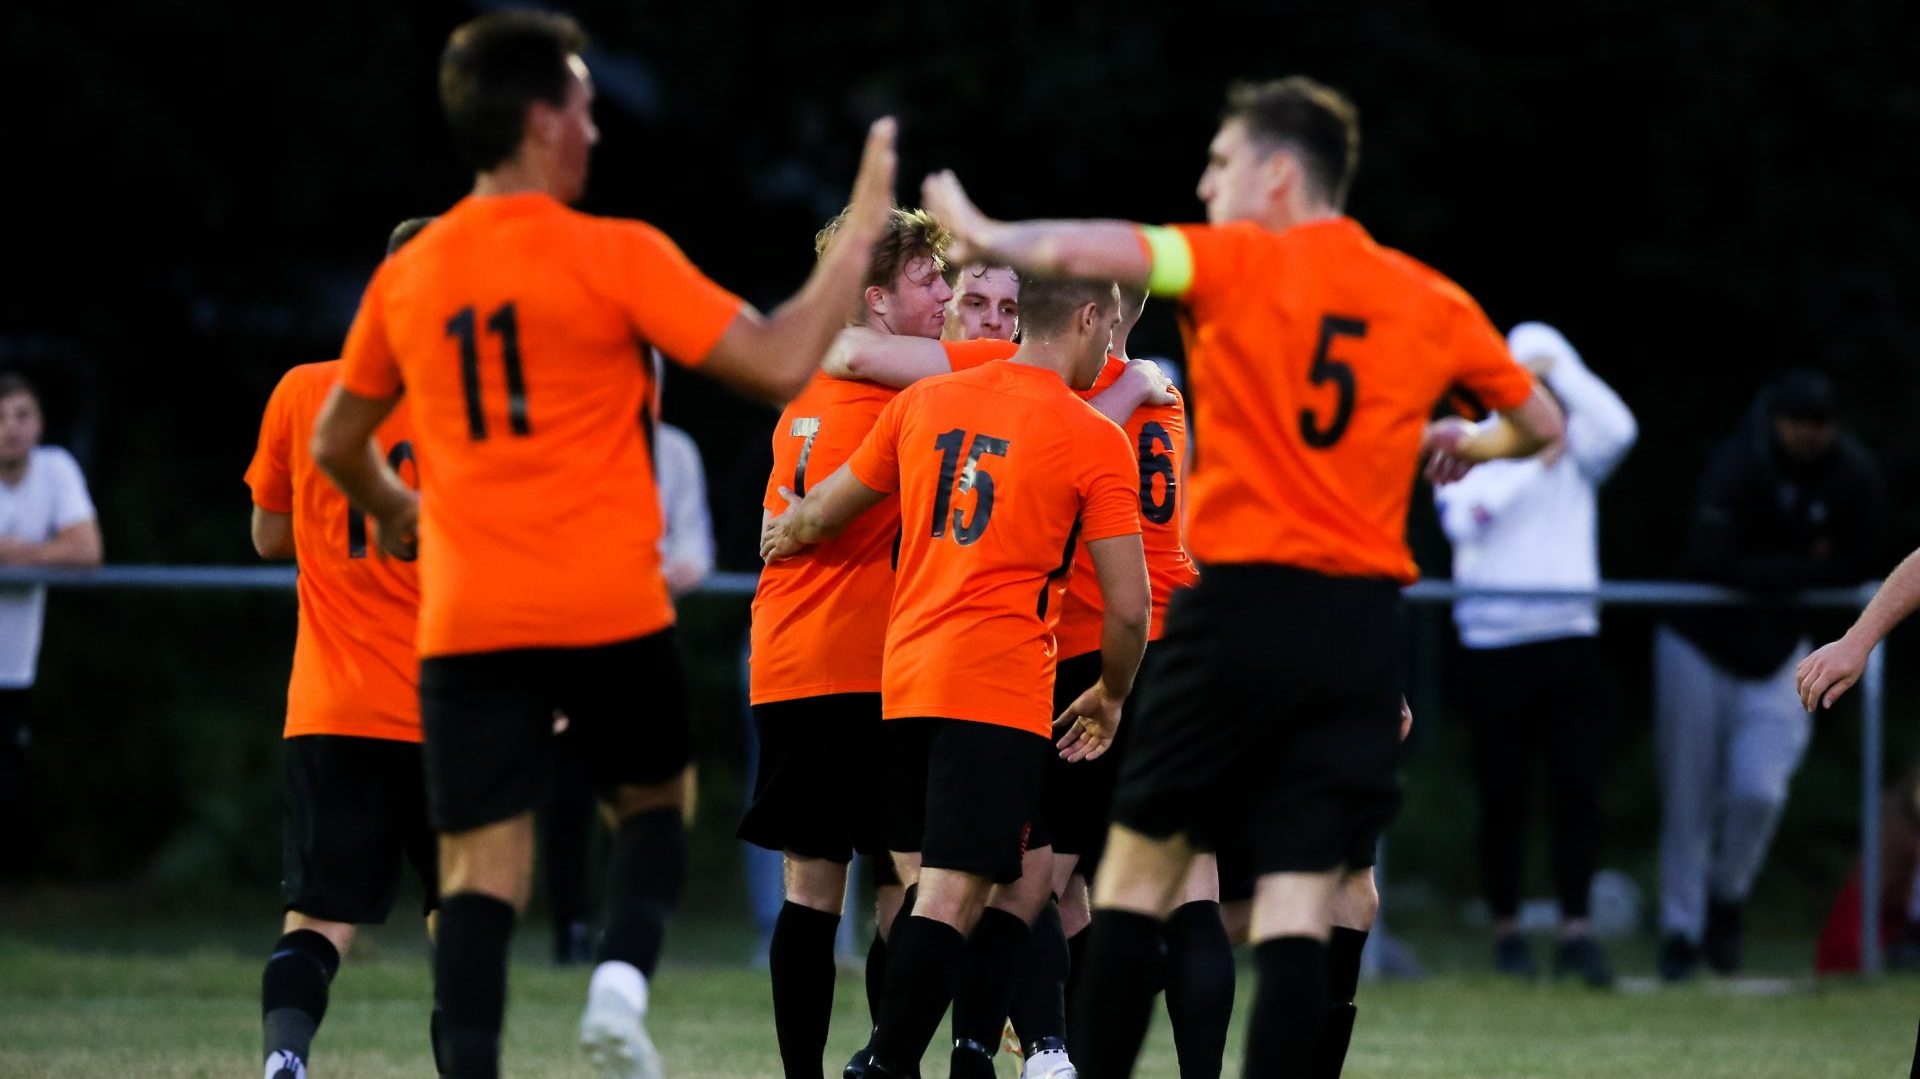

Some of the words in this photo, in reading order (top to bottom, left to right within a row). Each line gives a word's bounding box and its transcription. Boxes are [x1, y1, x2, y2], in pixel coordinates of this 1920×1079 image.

[444, 303, 532, 442] 11
[1300, 314, 1367, 449] 5
[791, 417, 821, 499] 7
[930, 428, 1010, 546] 15
[1138, 421, 1176, 525] 6
